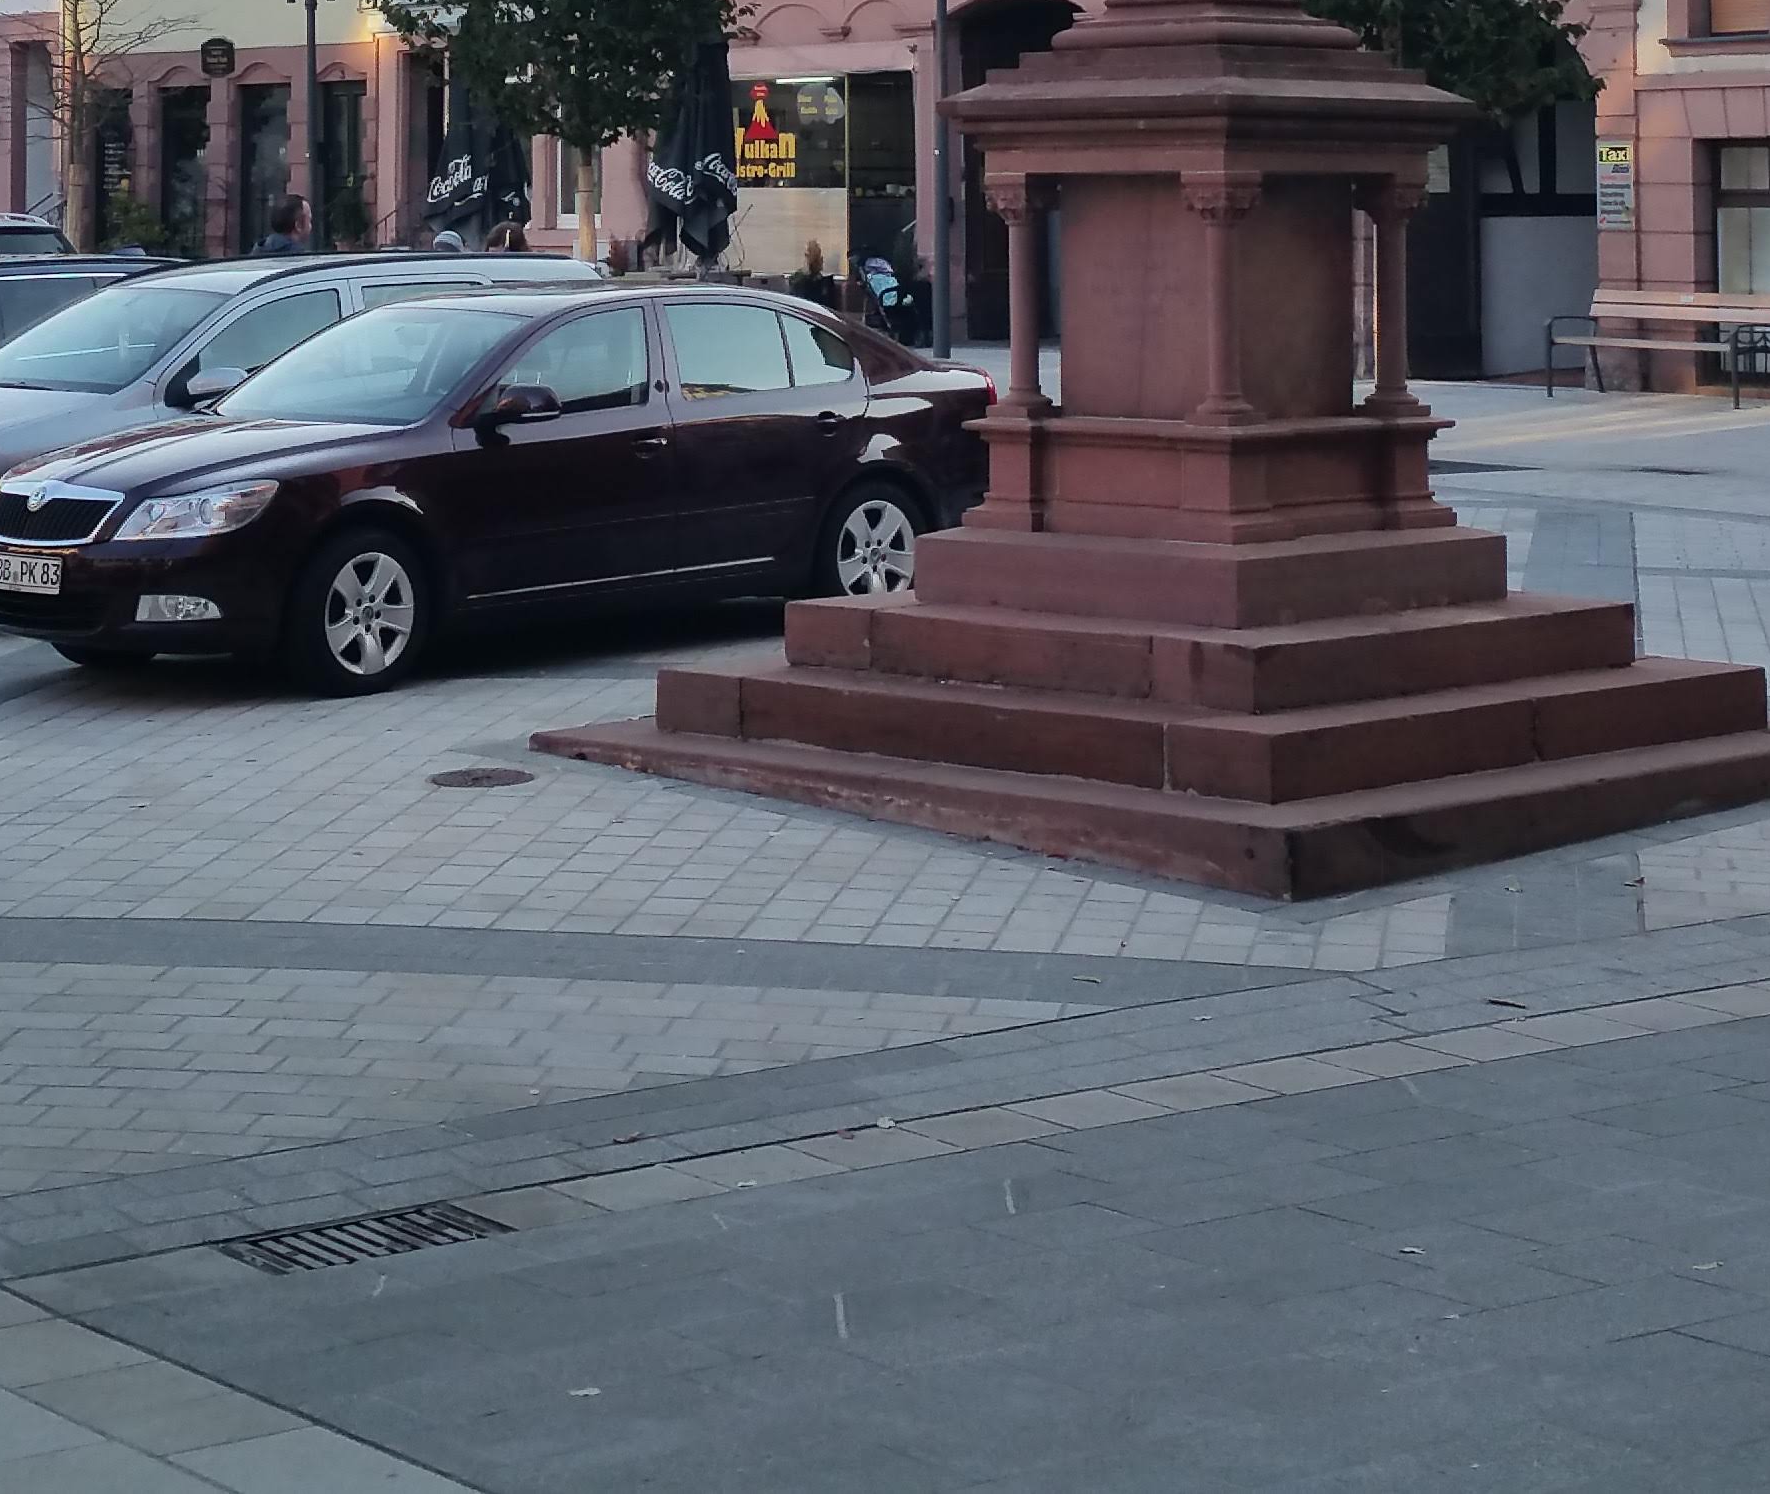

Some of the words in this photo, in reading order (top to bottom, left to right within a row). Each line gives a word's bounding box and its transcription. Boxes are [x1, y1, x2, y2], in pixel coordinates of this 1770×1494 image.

[1599, 147, 1630, 162] Taxi
[736, 161, 796, 178] istro-Grill
[20, 560, 38, 584] PK
[40, 563, 60, 586] 83
